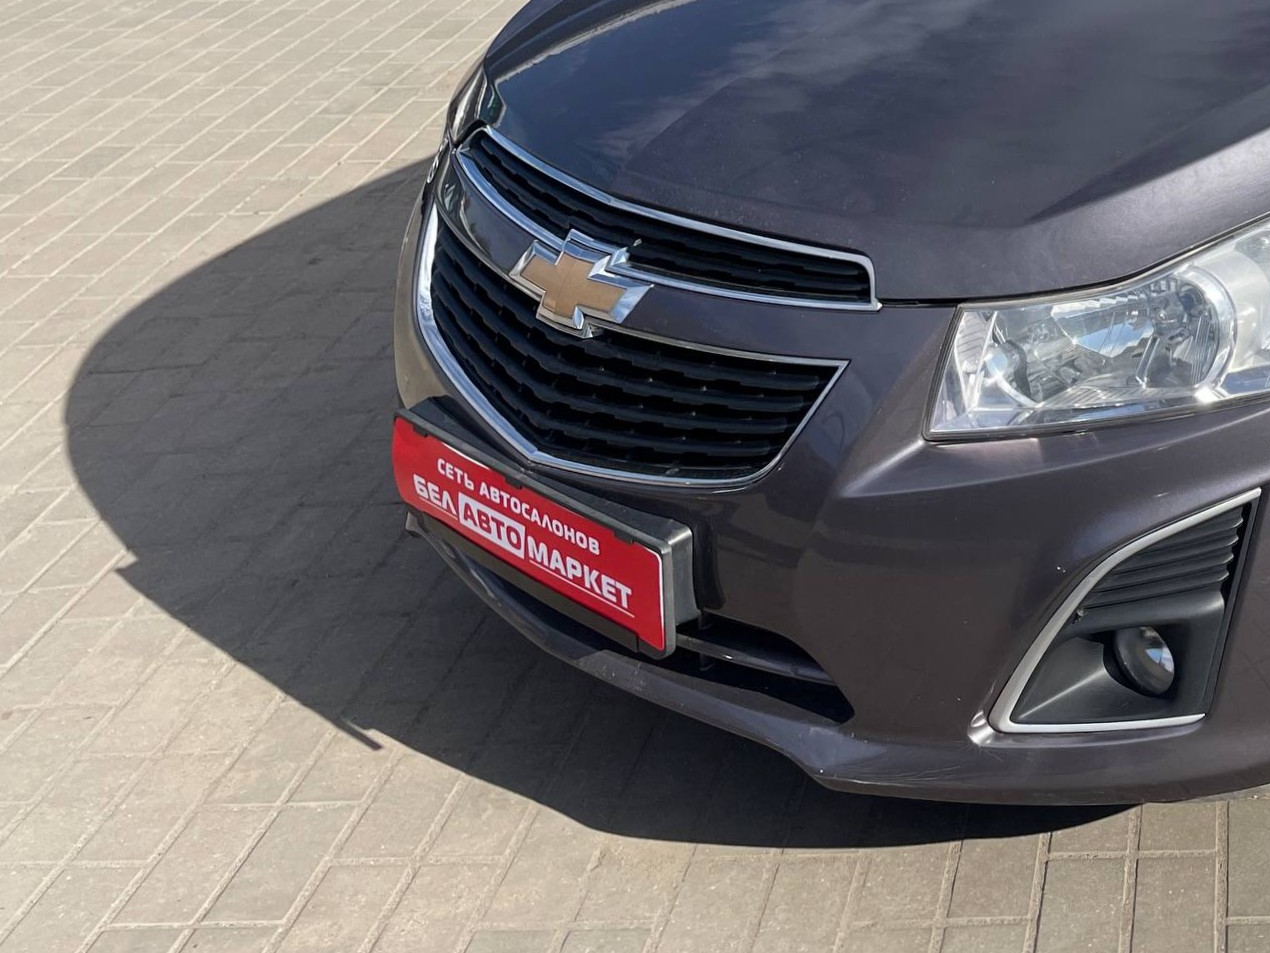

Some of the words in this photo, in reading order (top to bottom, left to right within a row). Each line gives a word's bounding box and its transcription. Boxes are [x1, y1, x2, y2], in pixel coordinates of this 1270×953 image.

[413, 473, 458, 515] БЕЛ
[462, 507, 523, 549] АВТО
[527, 535, 632, 609] МАРКЕТ
[436, 458, 475, 491] СЕТЬ
[479, 482, 600, 555] АВТОСАЛОНОВ
